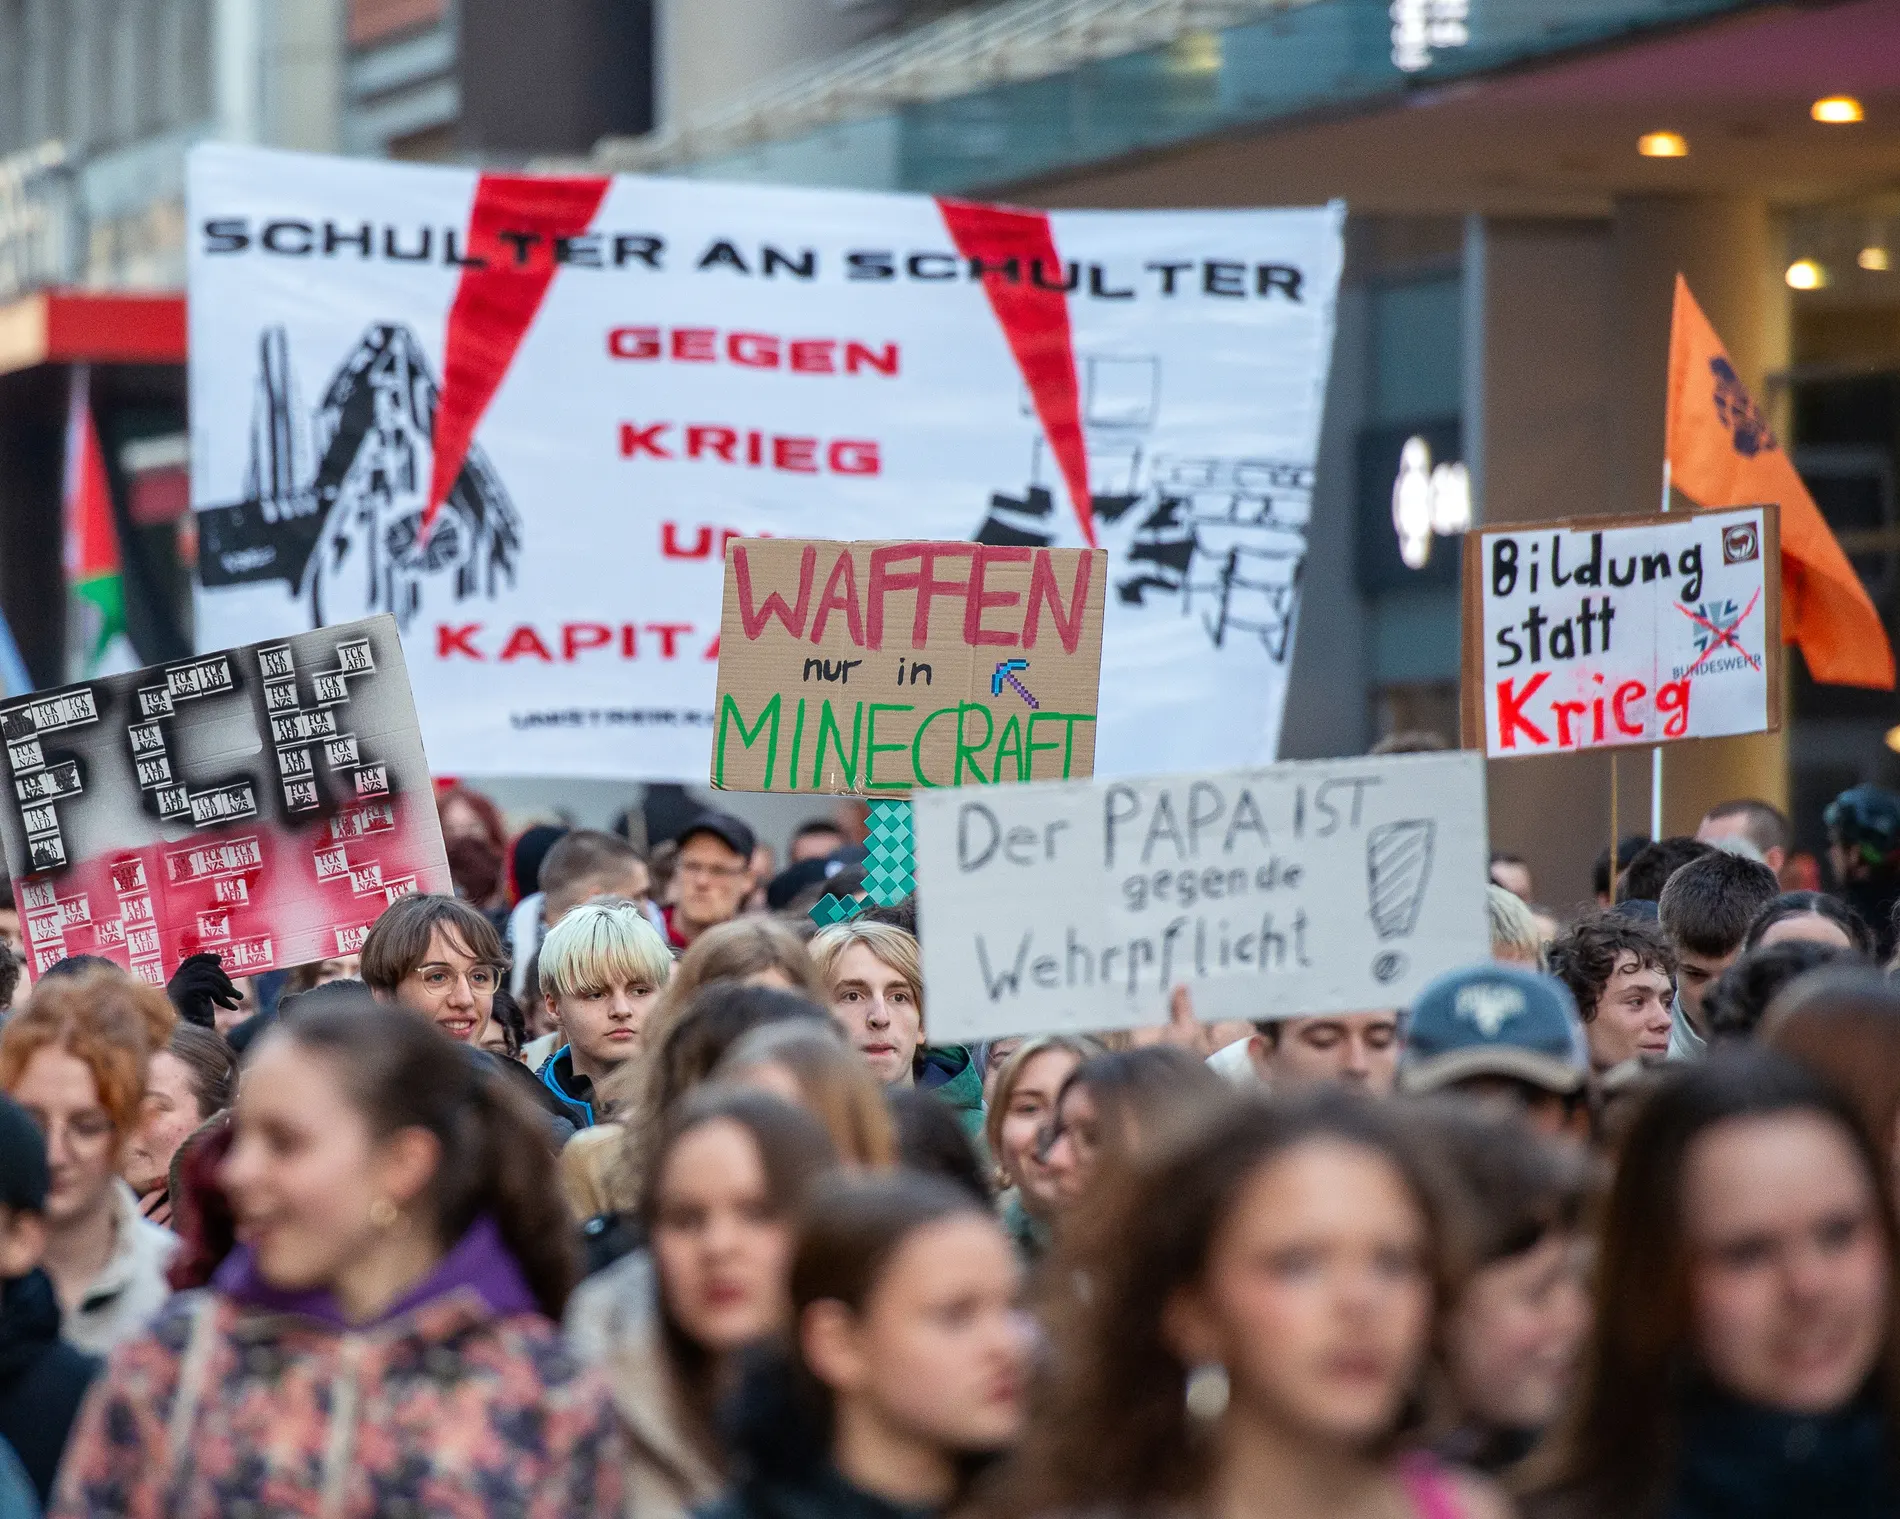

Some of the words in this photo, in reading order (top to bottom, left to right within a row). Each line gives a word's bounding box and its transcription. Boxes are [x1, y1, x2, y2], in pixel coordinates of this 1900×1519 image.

[202, 217, 663, 272] SCHULTER
[700, 238, 815, 279] AN
[846, 249, 1306, 302] SCHULTER
[608, 324, 901, 377] GEGEN
[617, 421, 882, 475] KRIEG
[1492, 532, 1704, 603] Bildung
[733, 543, 1092, 654] WAFFEN
[1497, 596, 1616, 668] statt
[434, 621, 720, 663] KAPIT
[265, 652, 286, 666] FCK
[344, 646, 365, 660] FCK
[268, 662, 288, 676] AFD
[348, 658, 366, 670] AFD
[803, 657, 862, 684] nur
[897, 657, 932, 685] in
[172, 670, 192, 685] FCK
[204, 664, 223, 679] FCK
[176, 682, 195, 694] NZS
[320, 676, 340, 690] FCK
[145, 691, 166, 705] FCK
[270, 684, 290, 699] FCK
[322, 687, 342, 700] AFD
[68, 695, 88, 710] FCK
[148, 702, 168, 715] NZS
[274, 696, 292, 708] NZS
[38, 702, 58, 718] FCK
[1496, 671, 1691, 749] Krieg
[41, 714, 60, 727] AFD
[277, 718, 298, 732] FCK
[308, 712, 328, 726] FCK
[136, 726, 156, 742] FCK
[280, 729, 299, 740] AFD
[310, 724, 330, 736] NZS
[140, 738, 158, 750] NZS
[331, 740, 351, 755] FCK
[716, 692, 1096, 790] MINECRAFT
[15, 743, 35, 758] FCK
[284, 751, 304, 764] FCK
[18, 755, 38, 767] NZS
[334, 752, 352, 764] NZS
[144, 760, 164, 774] FCK
[287, 761, 306, 774] AFD
[147, 770, 164, 783] AFD
[361, 768, 380, 782] FCK
[290, 782, 310, 796] FCK
[362, 781, 382, 792] NZS
[162, 788, 182, 802] FCK
[165, 800, 184, 812] AFD
[230, 801, 249, 813] NZS
[30, 807, 50, 822] FCK
[200, 808, 218, 820] AFD
[957, 801, 1067, 874] Der
[1103, 781, 1270, 868] PAPA
[1292, 776, 1382, 839] IST
[204, 848, 222, 862] FCK
[234, 844, 254, 857] FCK
[205, 860, 224, 872] NZS
[236, 854, 254, 866] AFD
[320, 852, 340, 866] FCK
[324, 864, 342, 874] NZS
[355, 867, 376, 882] FCK
[28, 883, 48, 898] FCK
[358, 880, 378, 890] NZS
[64, 900, 84, 916] FCK
[125, 898, 146, 912] FCK
[66, 912, 85, 924] NZS
[128, 909, 147, 922] AFD
[35, 916, 54, 930] FCK
[38, 928, 56, 940] NZS
[100, 932, 120, 944] NZS
[133, 930, 152, 944] FCK
[204, 927, 224, 936] NZS
[342, 928, 362, 942] FCK
[136, 942, 154, 953] AFD
[975, 908, 1314, 1000] Wehrpflicht
[247, 953, 267, 964] NZS
